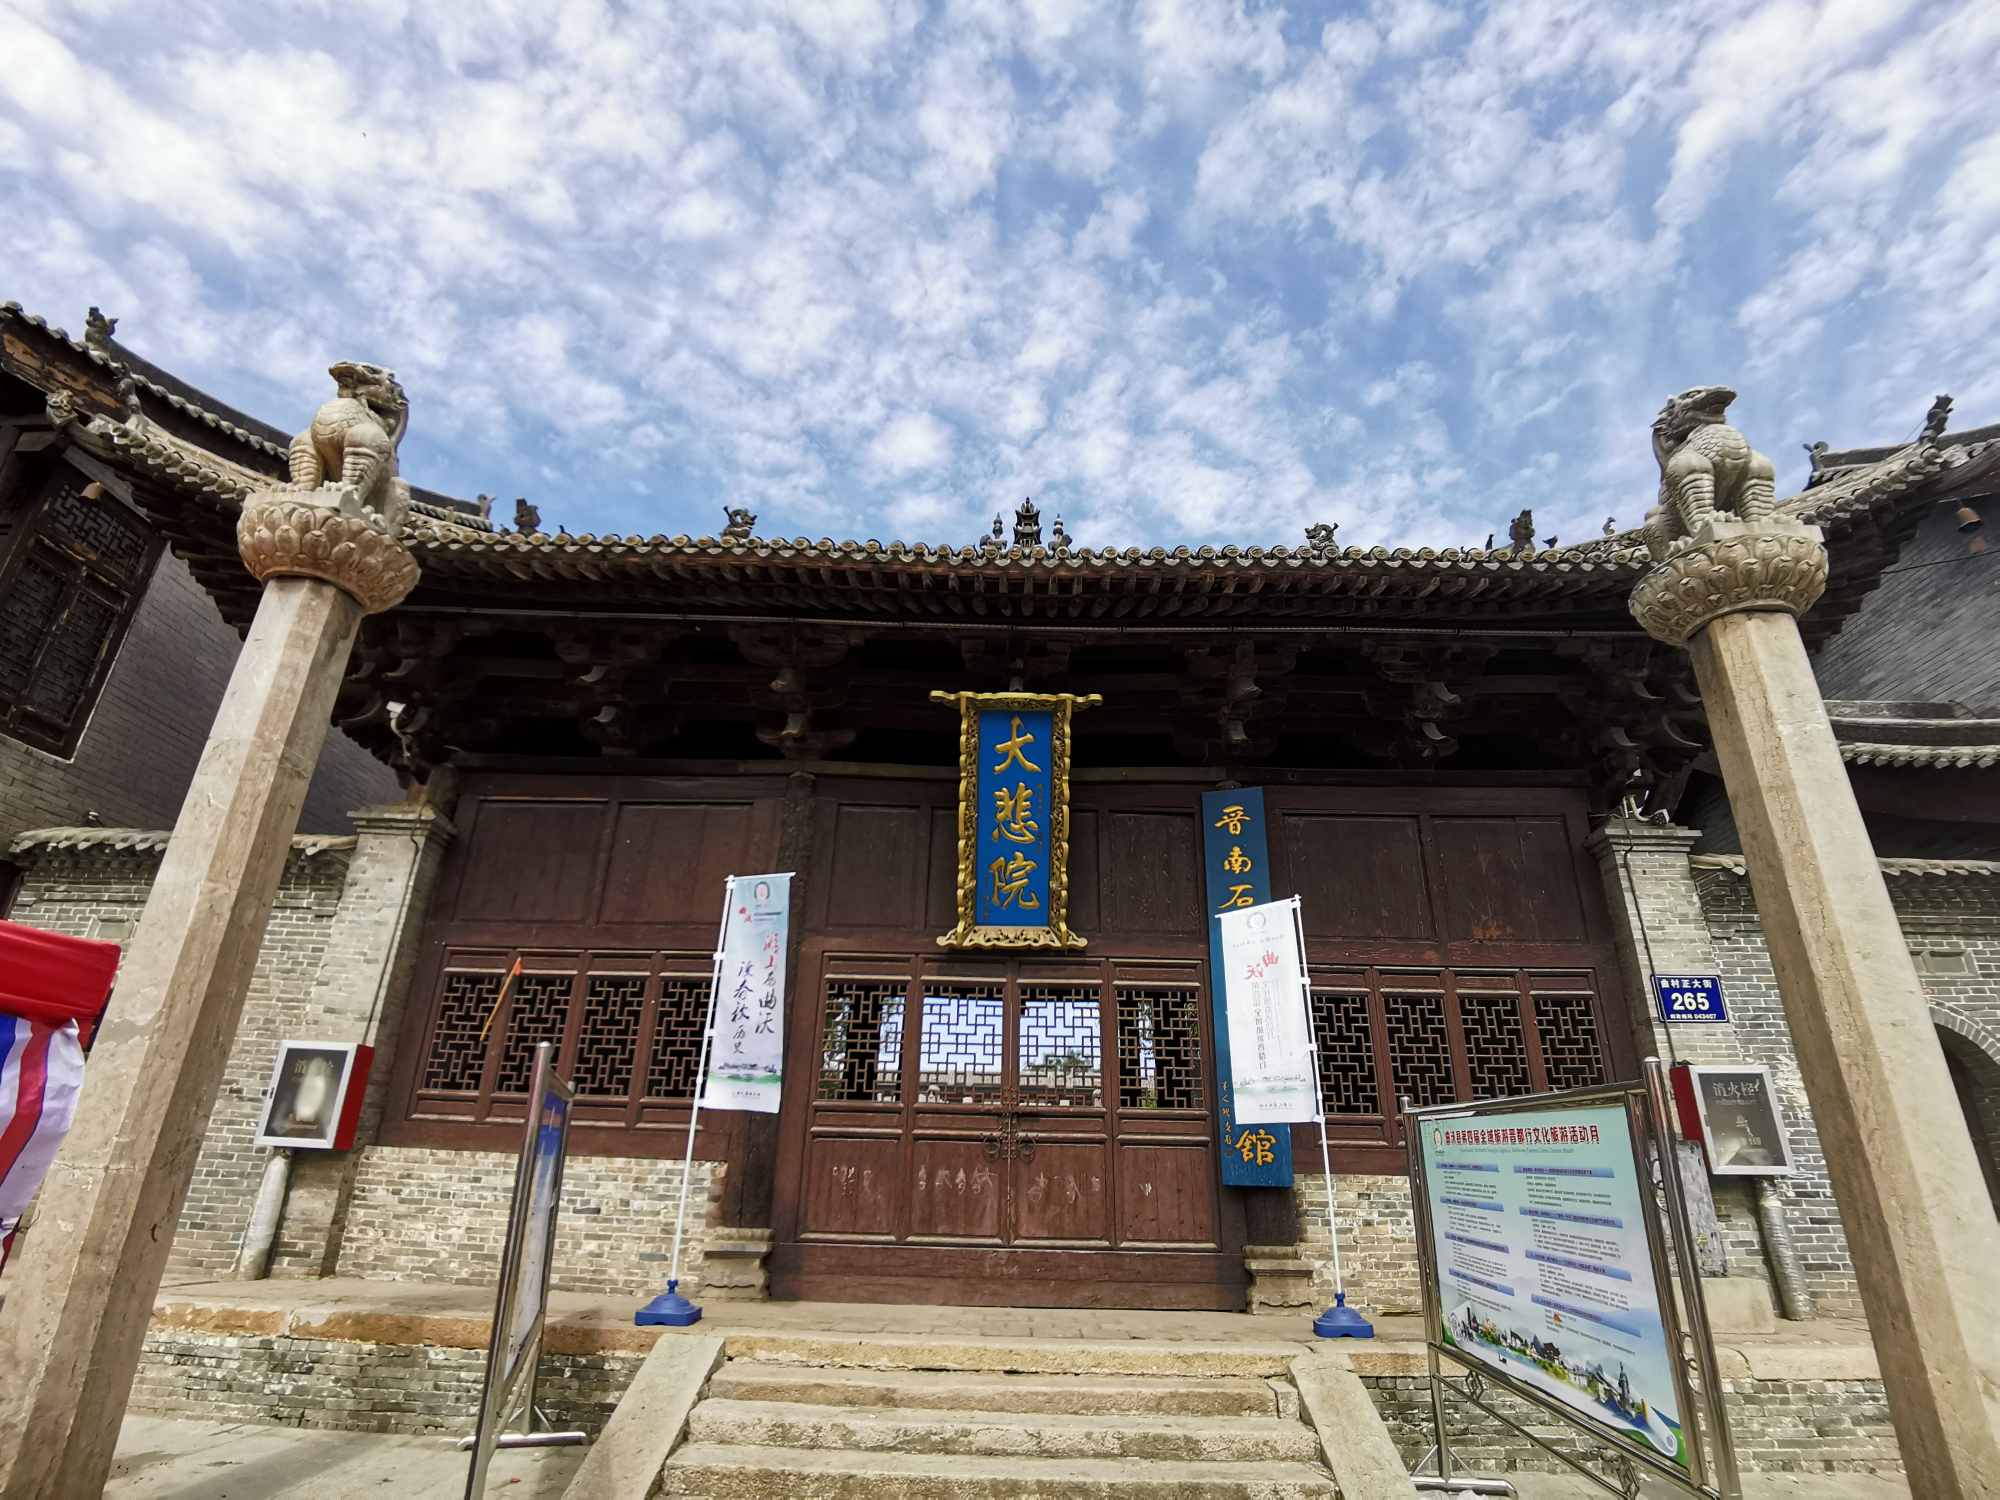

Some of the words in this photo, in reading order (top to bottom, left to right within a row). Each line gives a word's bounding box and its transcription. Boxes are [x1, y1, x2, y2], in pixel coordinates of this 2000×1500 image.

[989, 715, 1042, 909] 大悲院
[1661, 979, 1713, 988] 曲村正大街
[1671, 992, 1710, 1011] 265
